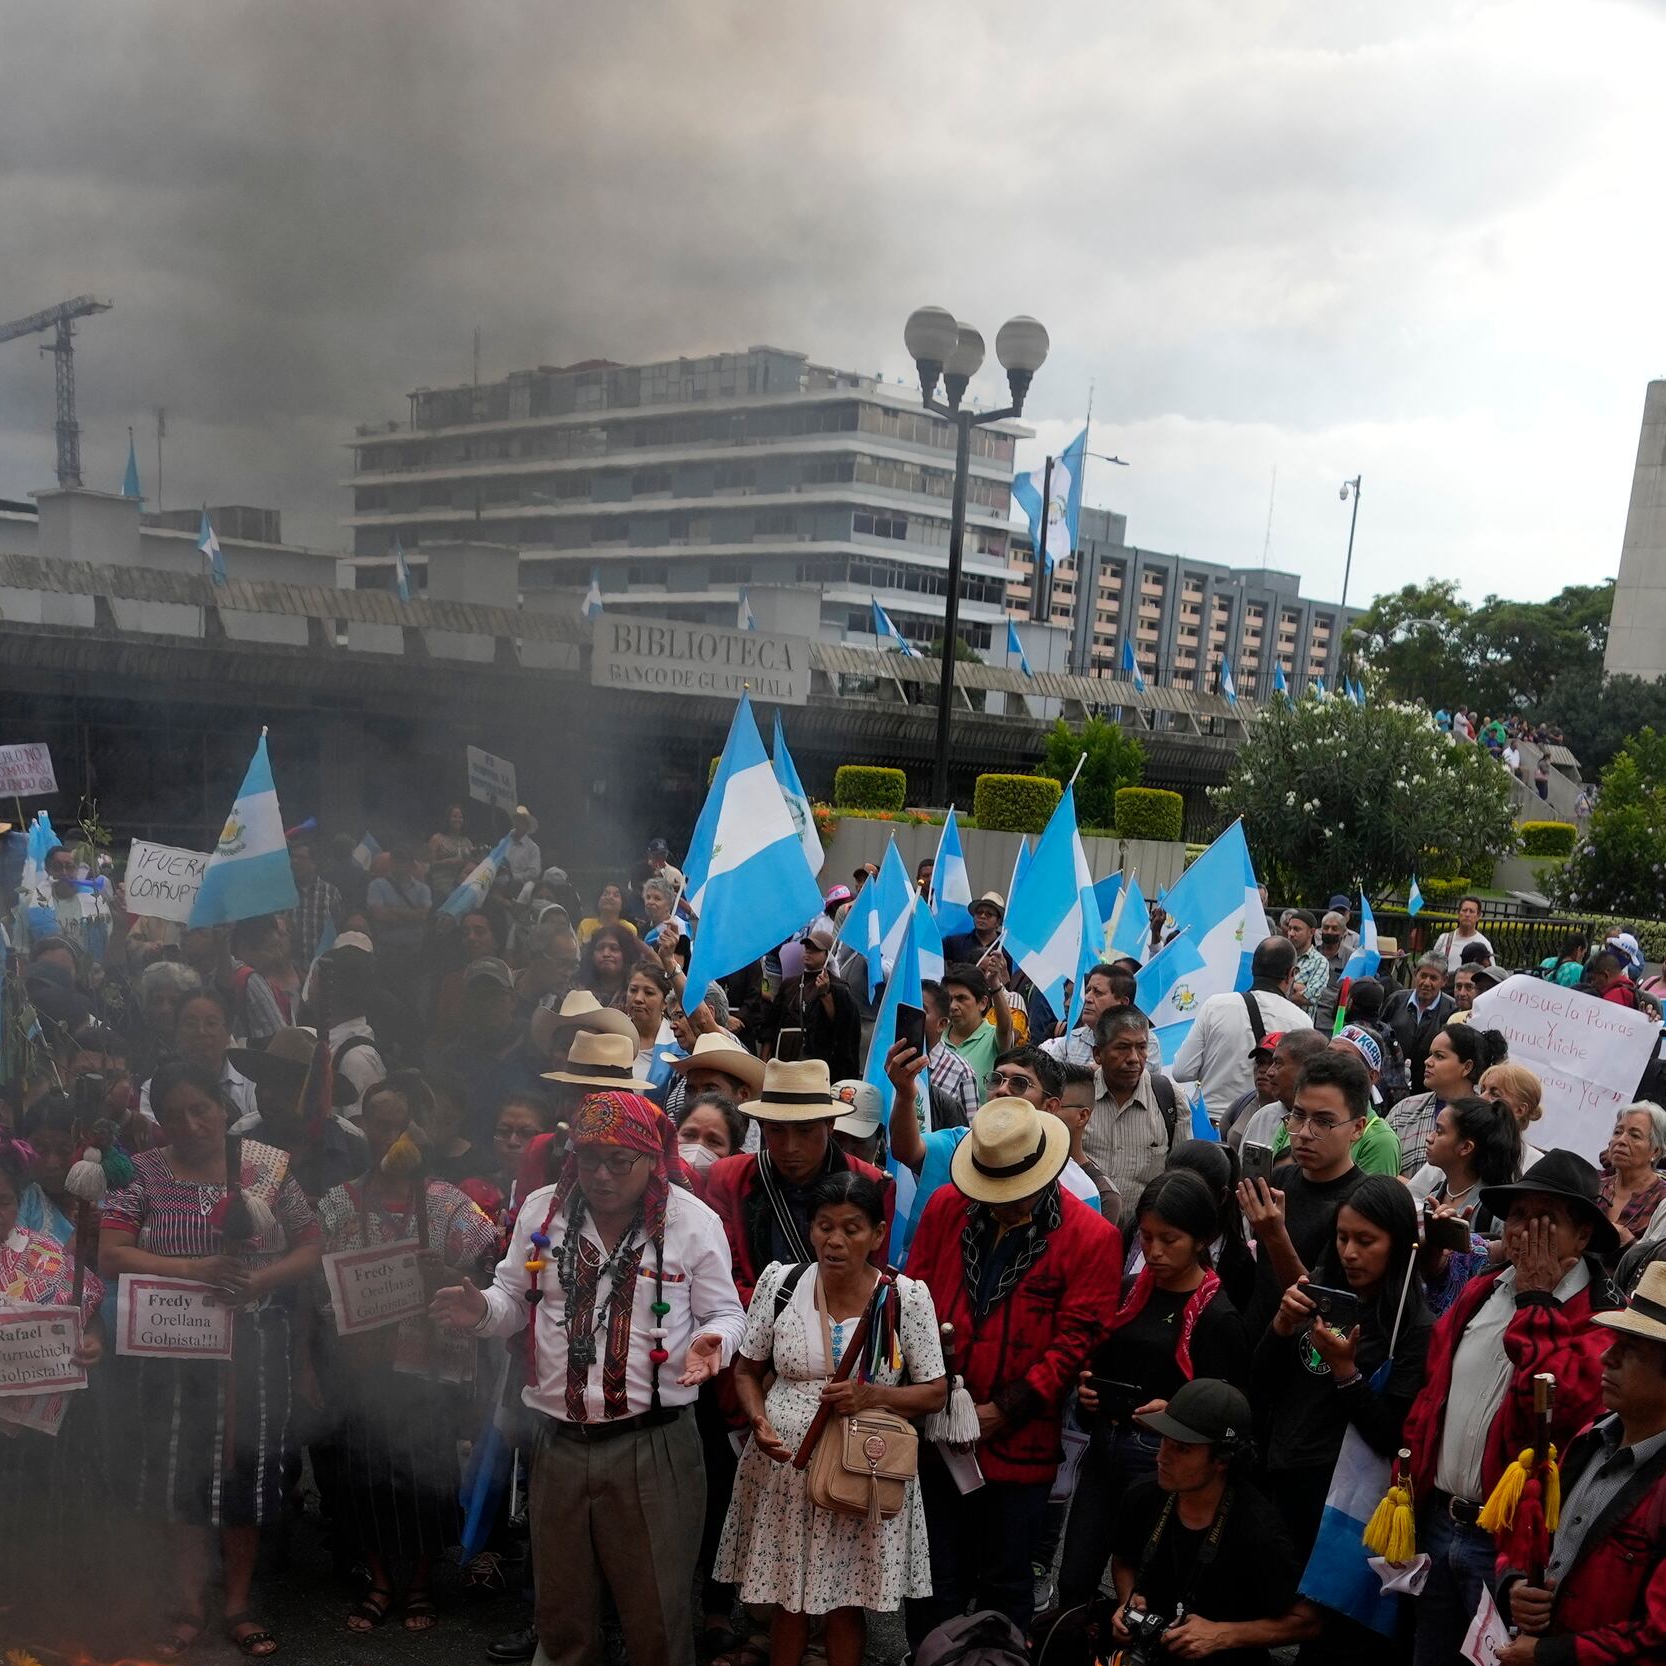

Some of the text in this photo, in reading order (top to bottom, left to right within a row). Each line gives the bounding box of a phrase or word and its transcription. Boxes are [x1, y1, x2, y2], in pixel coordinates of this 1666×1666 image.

[611, 623, 795, 673] BIBLIOTECA
[609, 663, 794, 698] BANCO DE GUATEMALA
[24, 746, 42, 761] NO
[130, 874, 201, 905] CORRUPT
[1586, 1006, 1634, 1038] Porras
[354, 1263, 395, 1282] Fredy
[360, 1277, 414, 1299] Orellana
[148, 1294, 194, 1311] Fredy
[150, 1312, 212, 1328] Orellana
[141, 1331, 219, 1348] Golpista!!!
